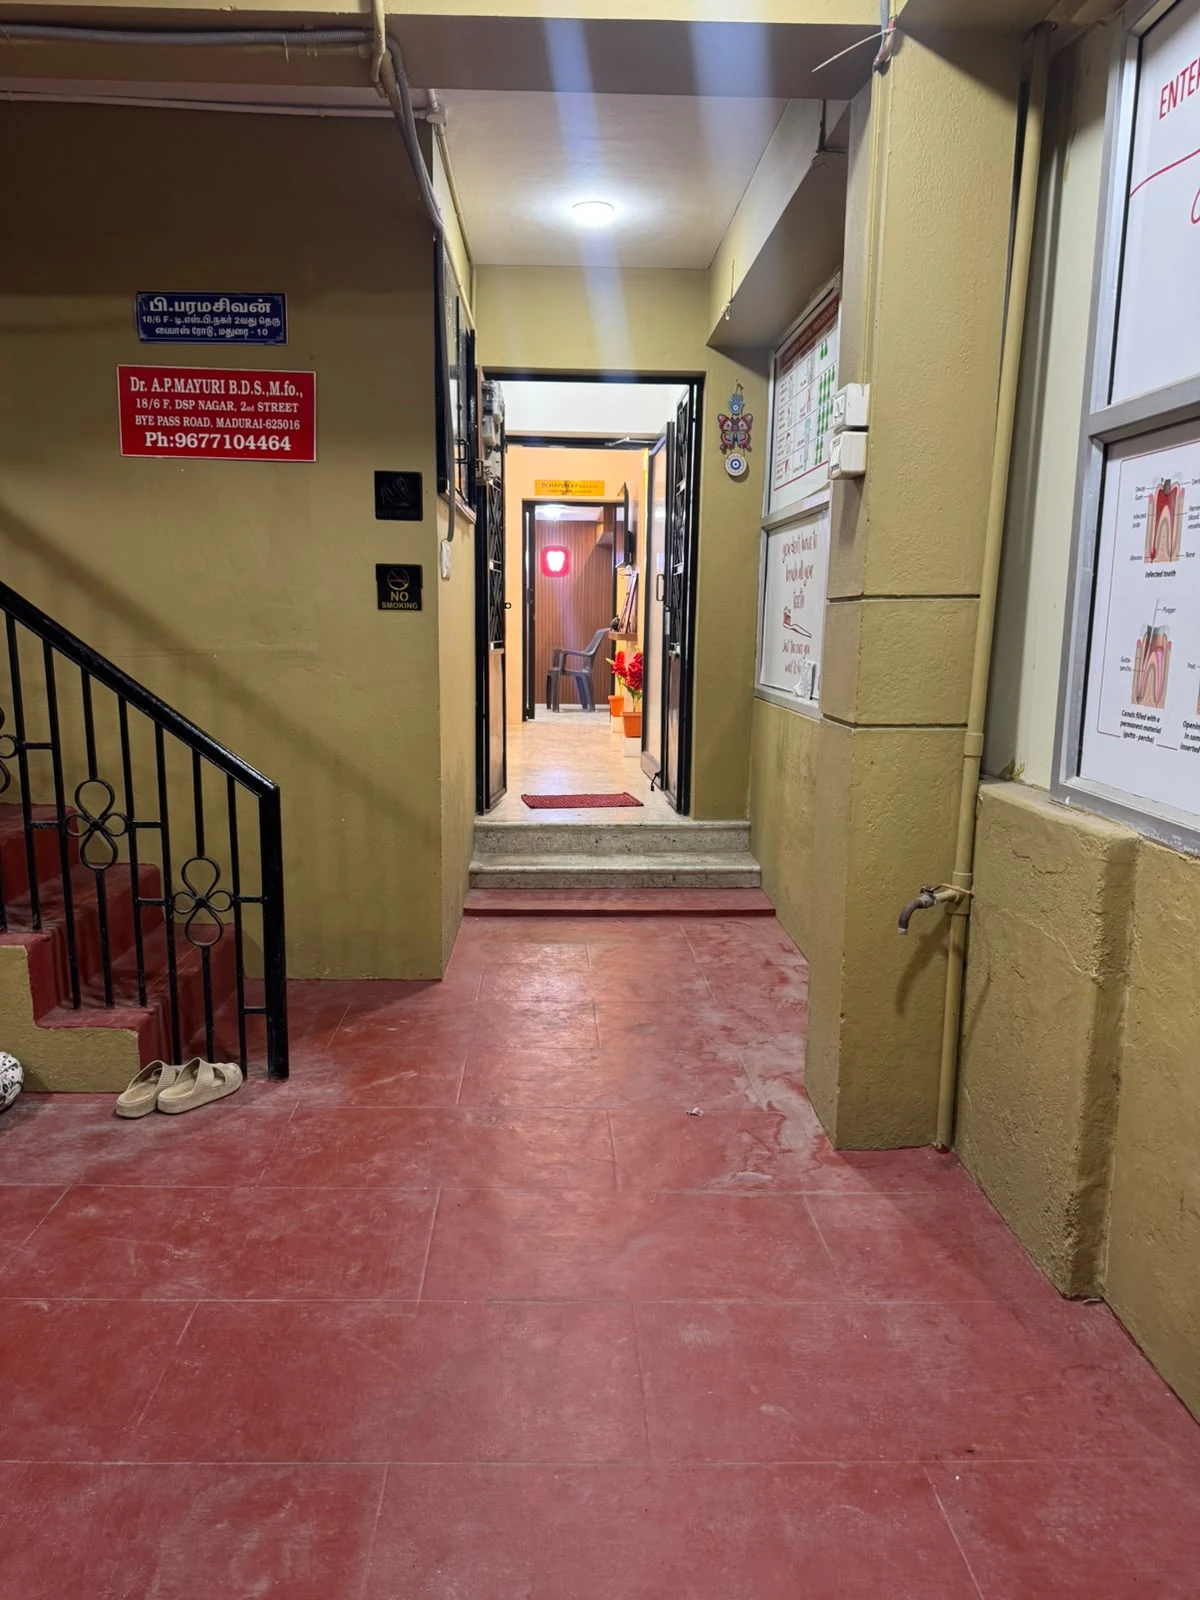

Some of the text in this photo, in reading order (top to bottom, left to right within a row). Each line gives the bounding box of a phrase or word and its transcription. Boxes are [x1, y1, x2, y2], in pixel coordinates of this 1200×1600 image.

[150, 297, 272, 314] பி.பரமசிவன்
[142, 315, 161, 324] 18/6
[256, 328, 268, 336] 10
[130, 376, 148, 392] Dr.
[151, 377, 225, 395] A.P.MAYURI
[136, 398, 160, 411] 18/6
[175, 400, 195, 411] DSP
[198, 400, 237, 413] NAGAR,
[240, 401, 255, 412] 2nd
[257, 402, 299, 413] STREET
[135, 415, 300, 430] BYE PASS ROAD, MADURAI-625016
[145, 431, 292, 451] Ph:9677104464
[390, 591, 409, 601] NO
[381, 601, 418, 609] SMOKING
[1121, 709, 1135, 718] Canals
[1135, 711, 1147, 721] filled
[1120, 720, 1162, 734] permanent material
